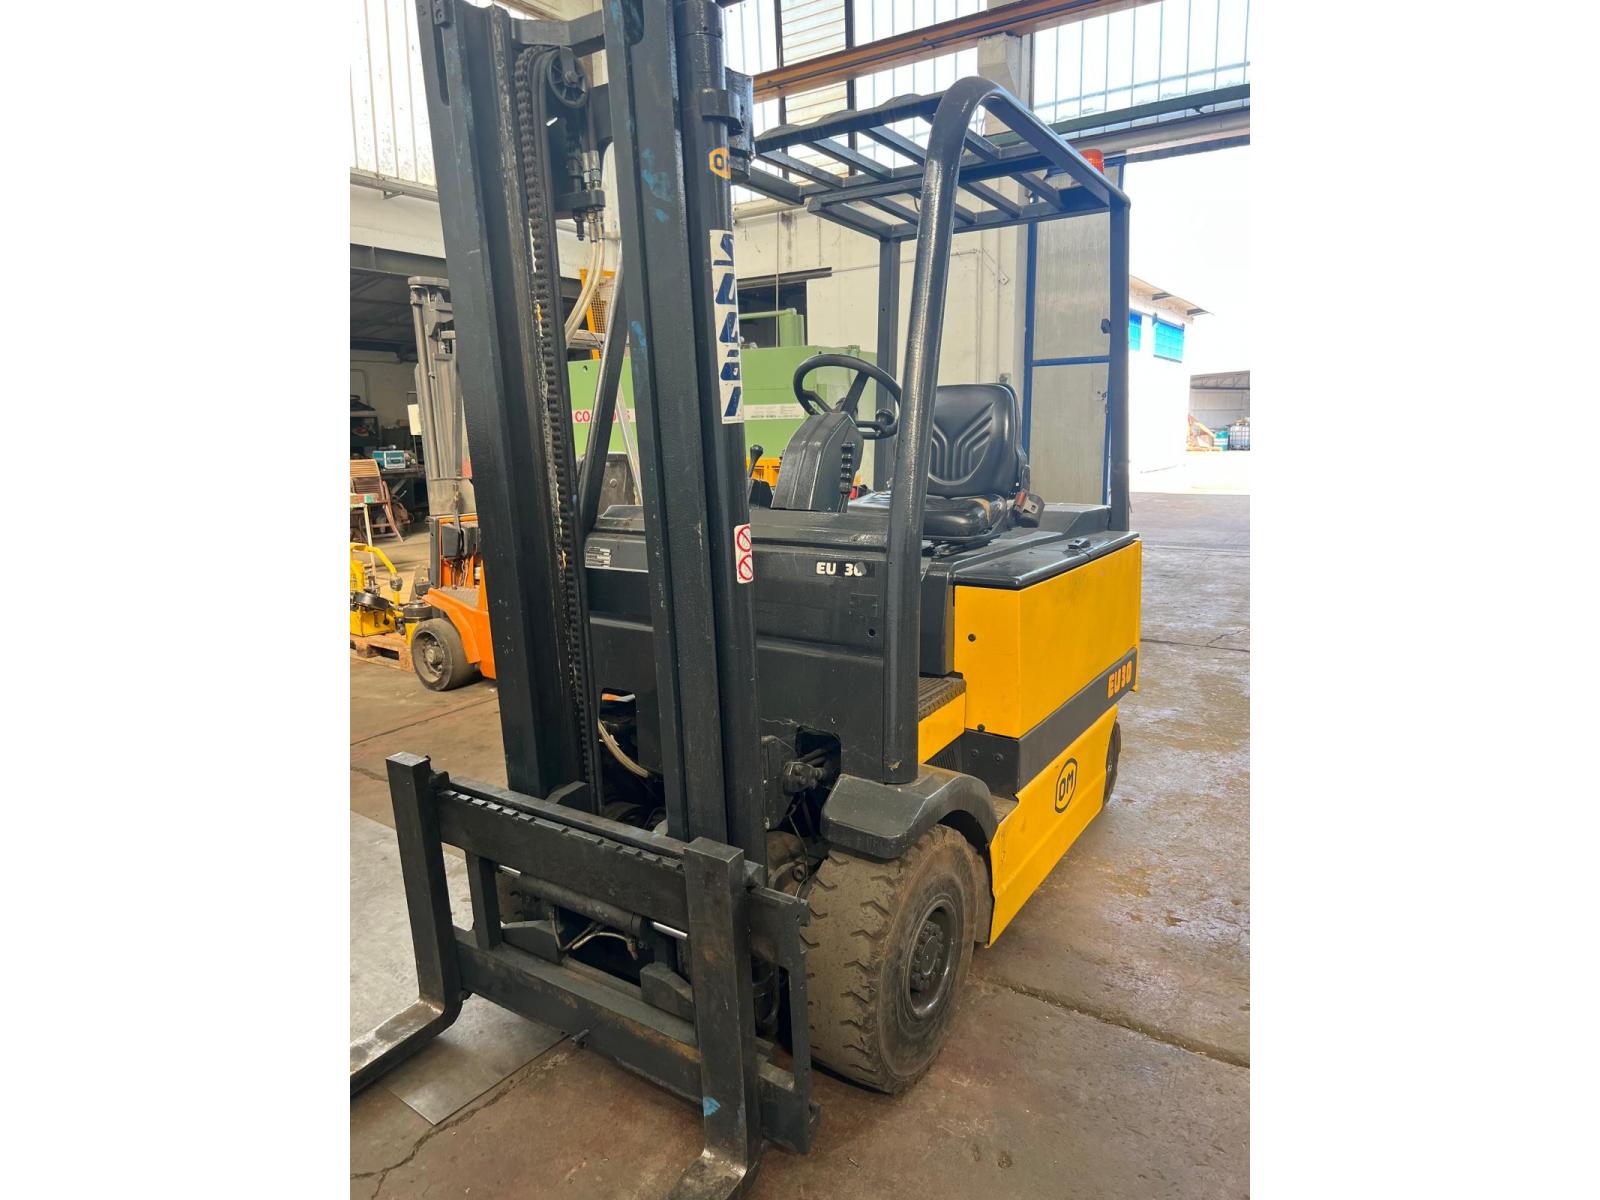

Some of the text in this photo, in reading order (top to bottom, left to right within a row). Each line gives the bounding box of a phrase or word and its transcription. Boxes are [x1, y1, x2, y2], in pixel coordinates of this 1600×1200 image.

[816, 561, 837, 575] EU
[1107, 660, 1132, 699] EU30
[1059, 769, 1074, 802] OM
